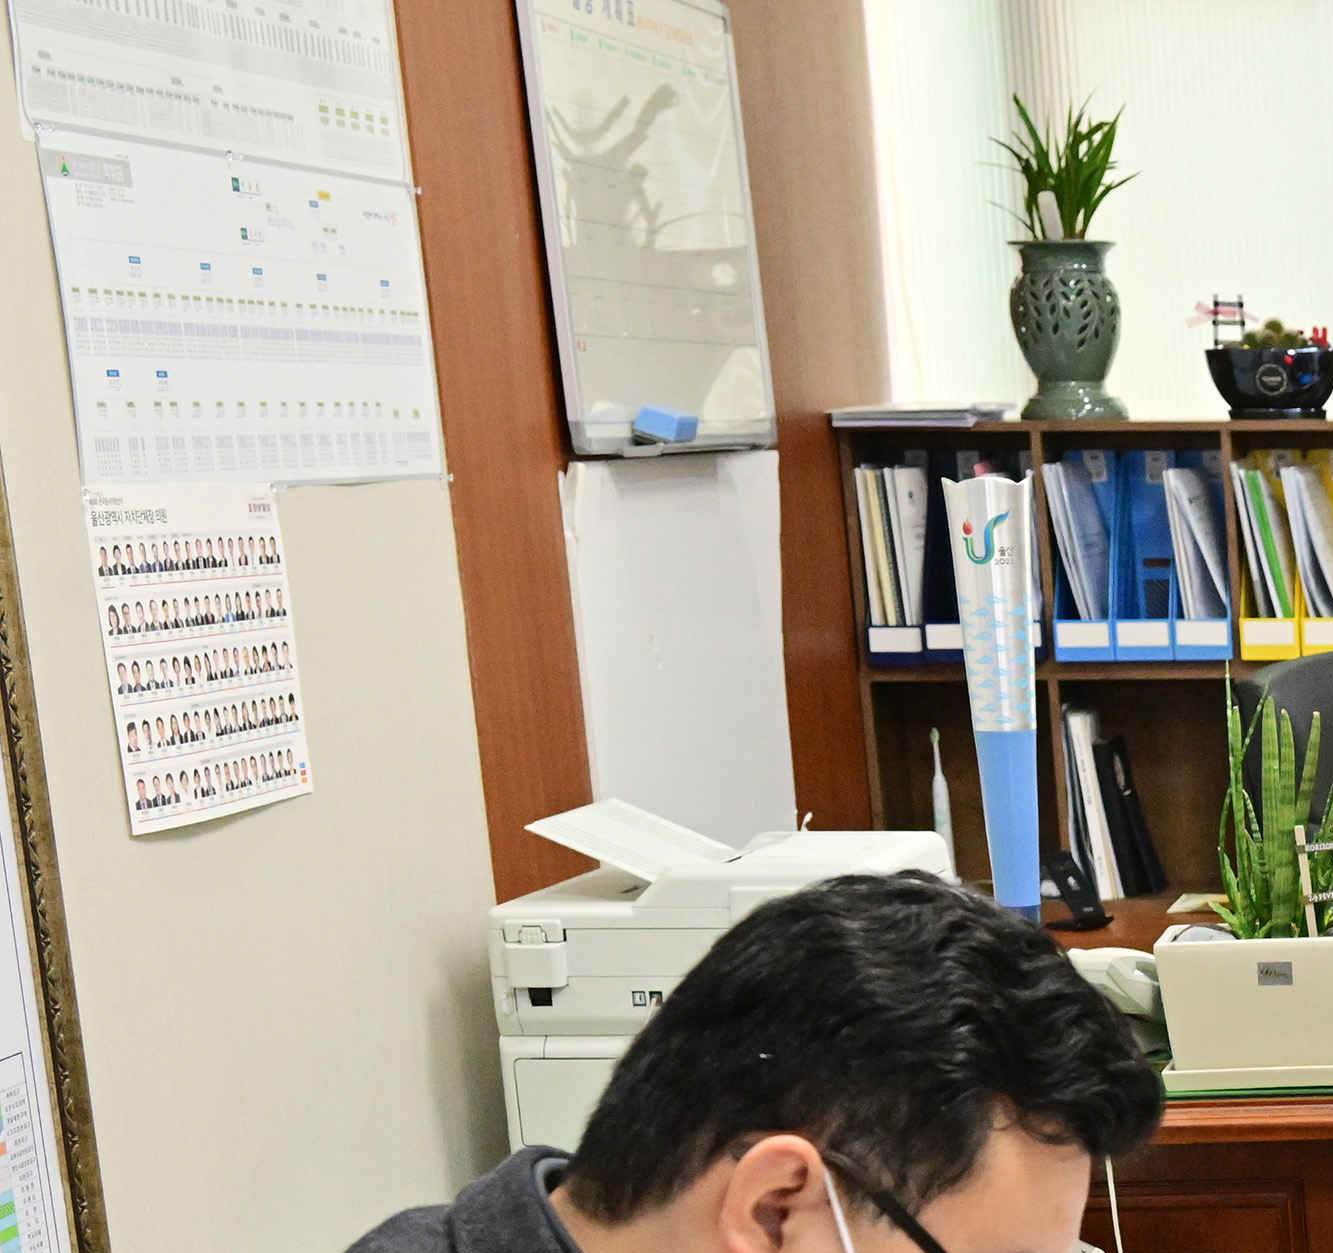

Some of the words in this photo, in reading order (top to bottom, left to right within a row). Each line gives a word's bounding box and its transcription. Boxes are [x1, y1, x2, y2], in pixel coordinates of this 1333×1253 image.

[90, 510, 123, 526] 울산광역시
[124, 509, 154, 524] 자치단체장
[155, 508, 168, 524] 의원
